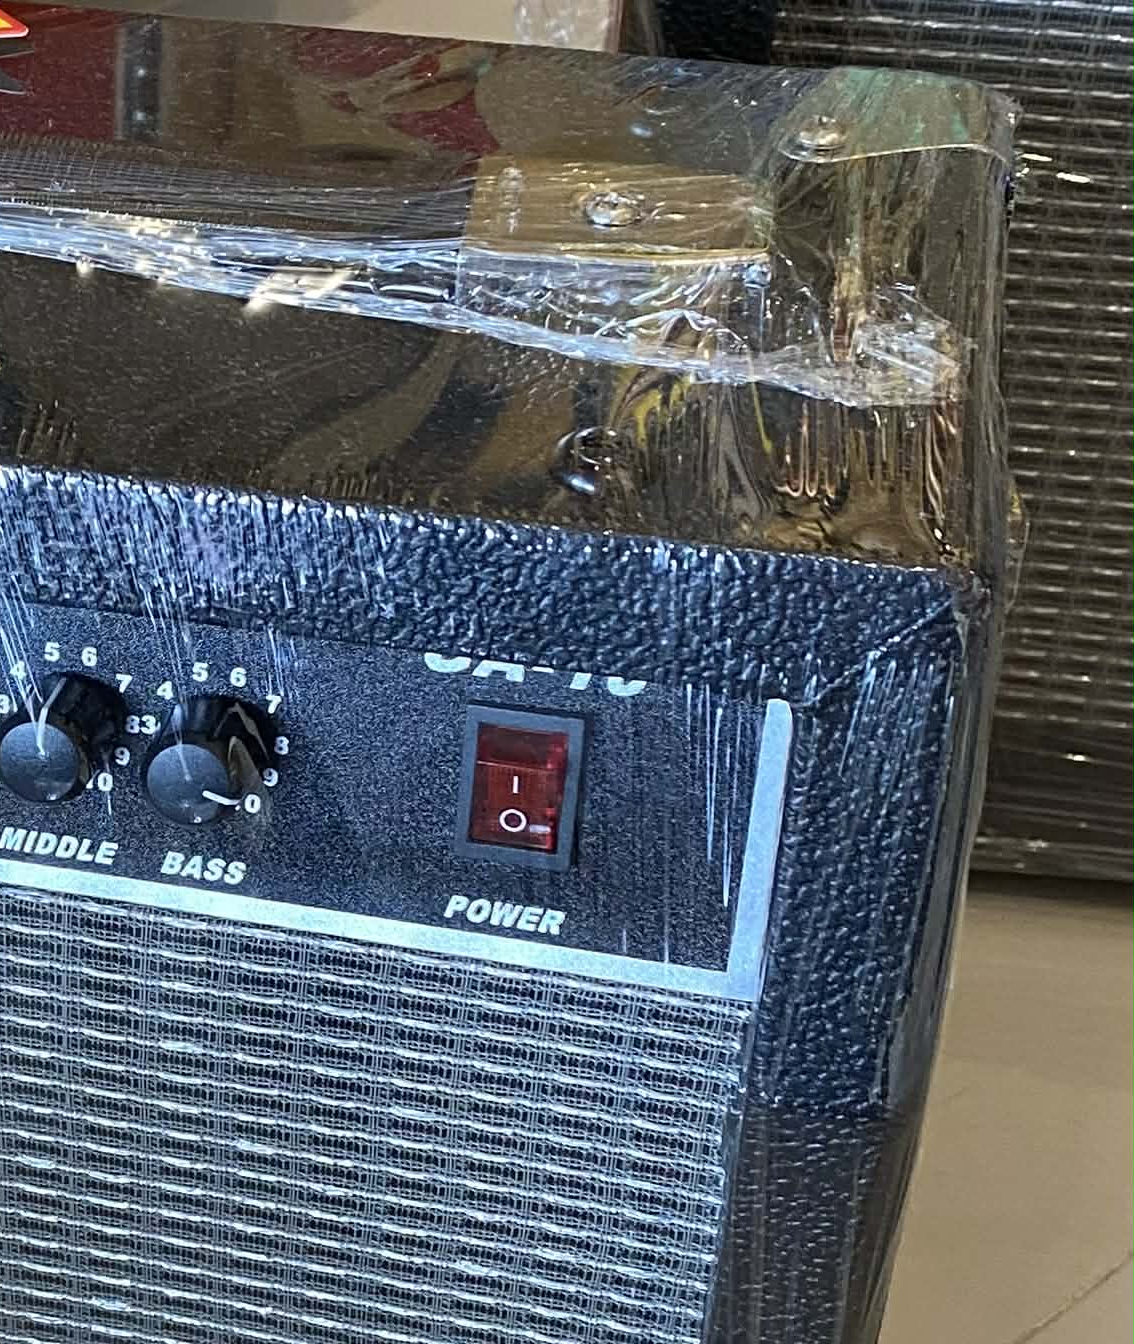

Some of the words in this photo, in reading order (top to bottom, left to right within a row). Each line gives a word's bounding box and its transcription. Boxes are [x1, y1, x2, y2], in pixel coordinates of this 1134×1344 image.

[44, 642, 60, 662] 5
[81, 647, 98, 667] 6
[10, 660, 26, 680] 4
[192, 662, 209, 682] 5
[230, 667, 247, 687] 6
[116, 673, 132, 693] 7
[157, 681, 173, 700] 4
[266, 695, 282, 714] 7
[126, 715, 140, 734] 8
[140, 714, 157, 735] 3
[274, 736, 289, 755] 8
[115, 747, 130, 766] 9
[263, 768, 278, 787] 9
[161, 850, 247, 885] BASS
[444, 895, 567, 935] POWER
